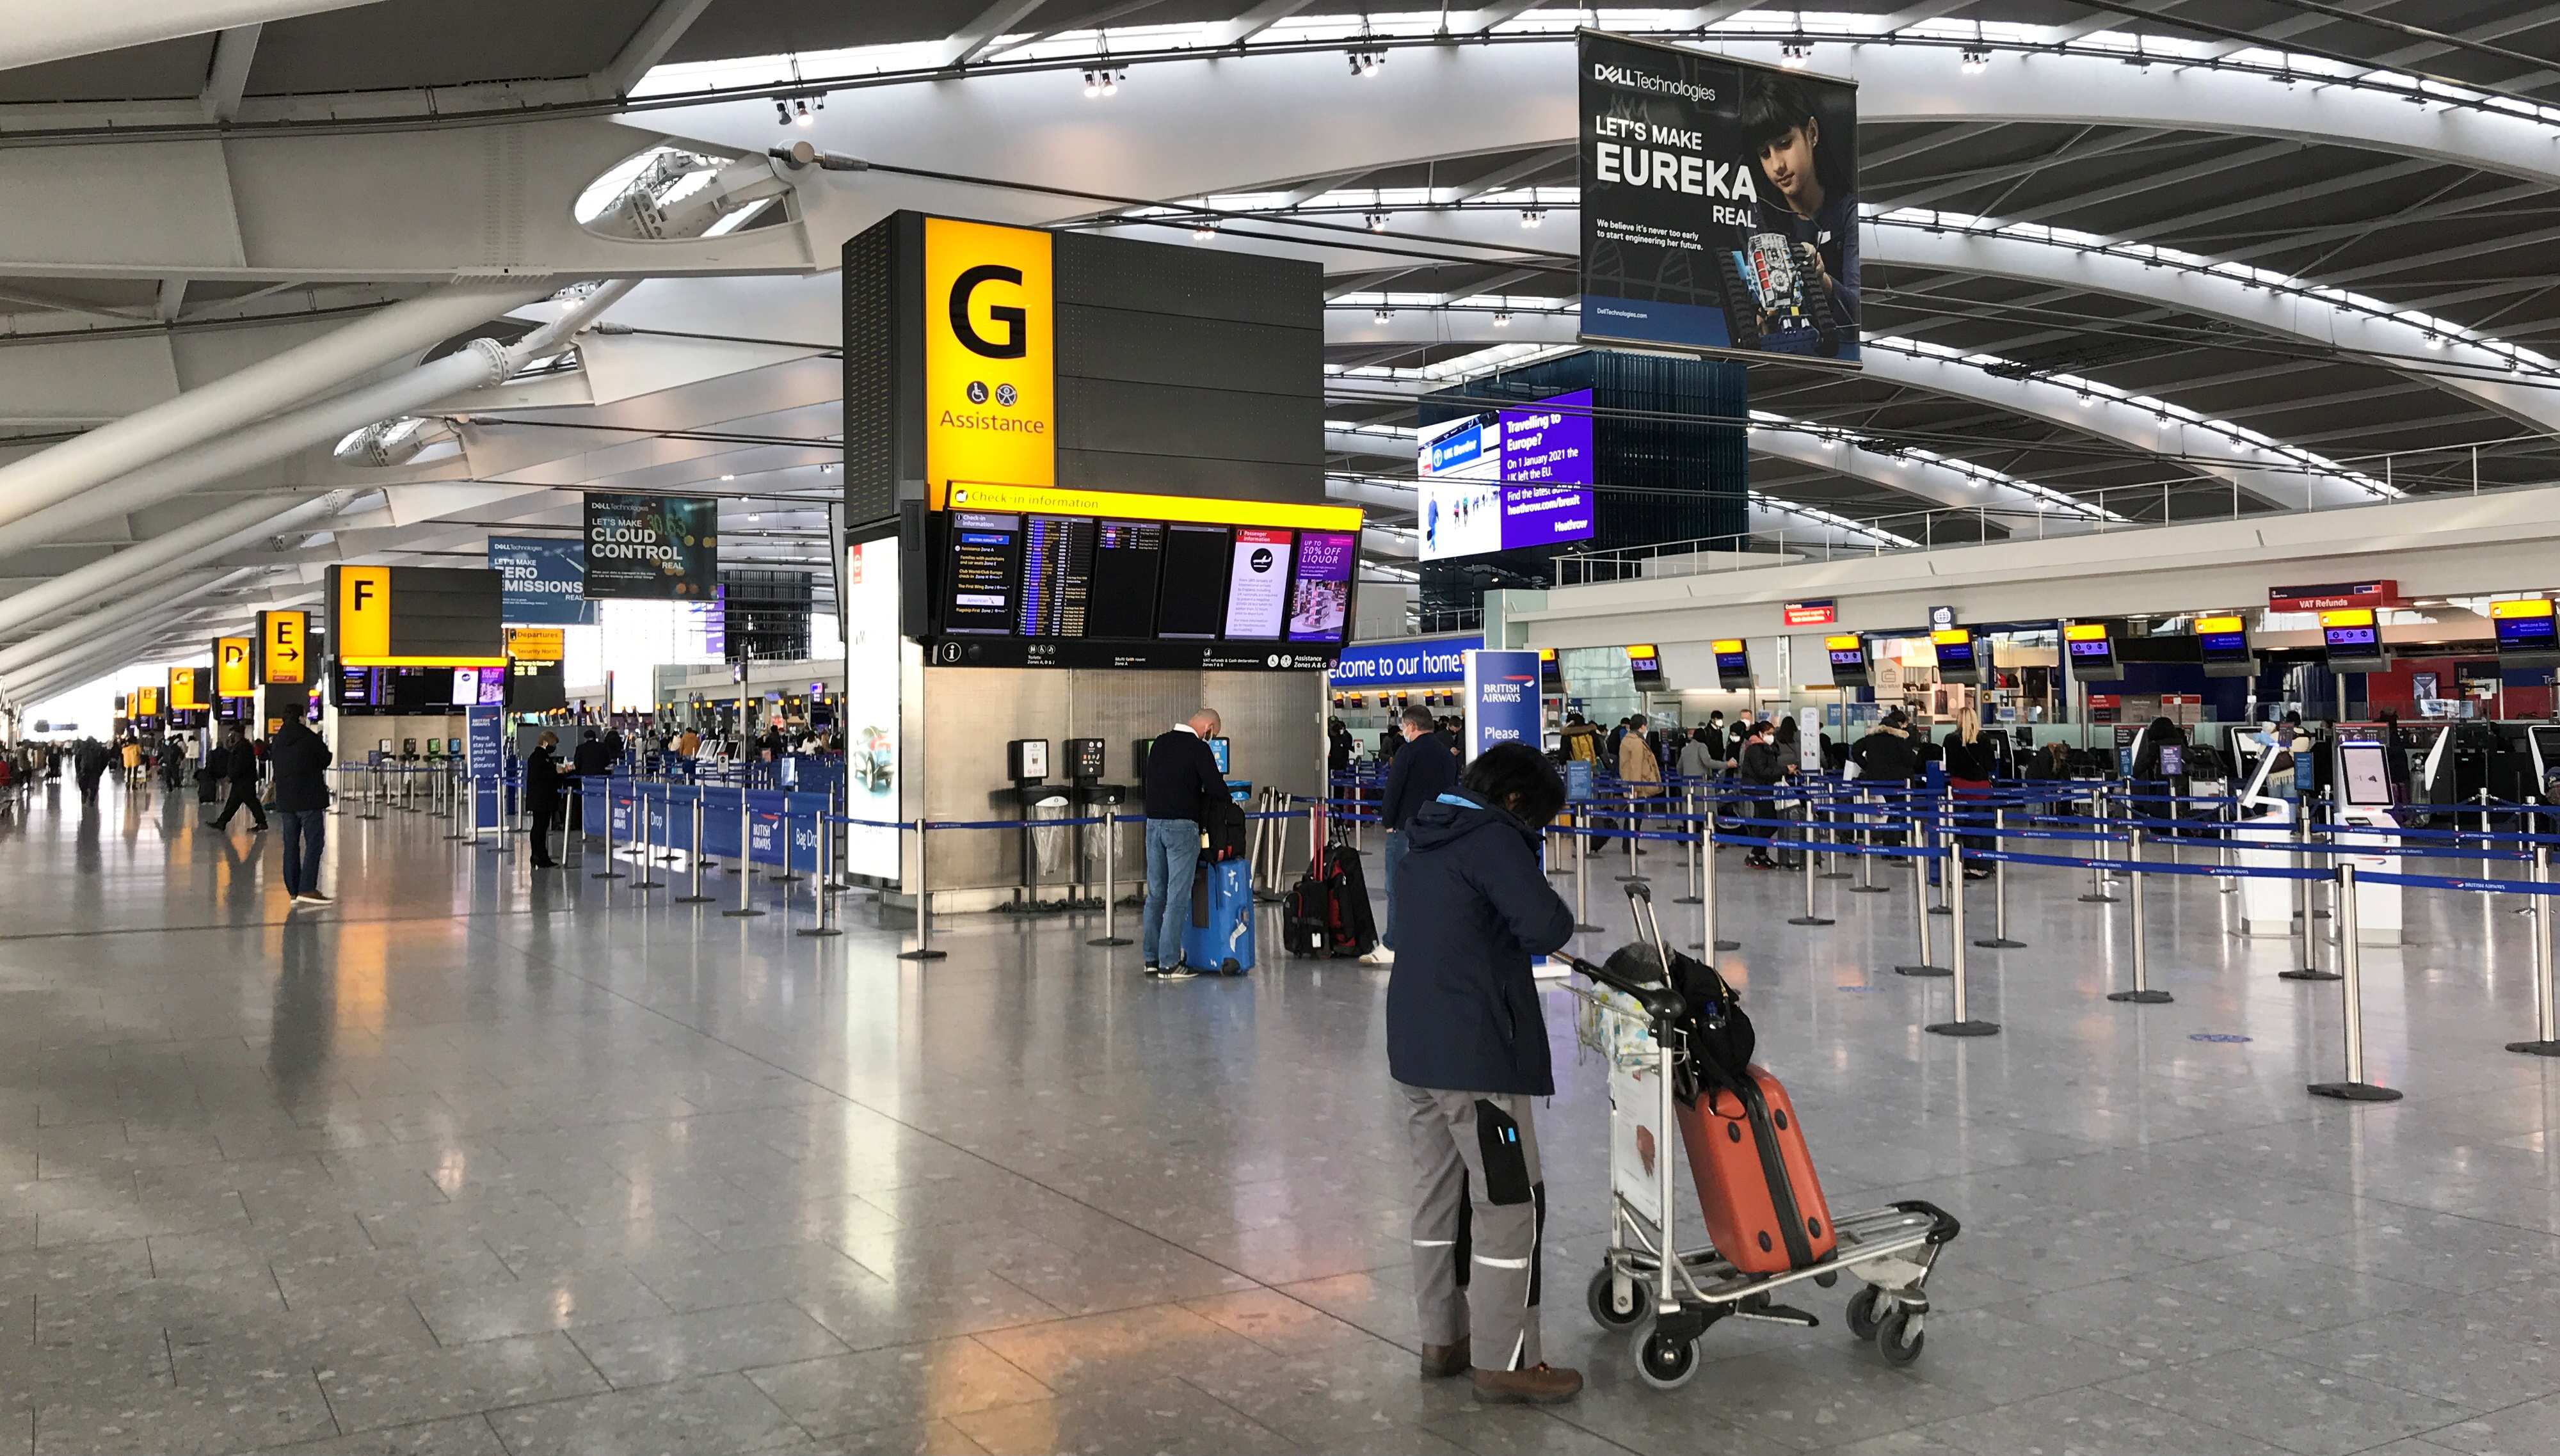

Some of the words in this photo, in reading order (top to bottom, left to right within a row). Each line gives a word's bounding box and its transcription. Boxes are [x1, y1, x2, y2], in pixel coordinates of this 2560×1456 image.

[1596, 115, 1646, 141] LET'S
[1652, 126, 1702, 150] MAKE
[1596, 142, 1757, 203] EUREKA
[1713, 205, 1757, 228] REAL
[1596, 218, 1608, 228] We
[1610, 221, 1635, 231] believe
[1636, 224, 1647, 233] it's
[1649, 227, 1668, 236] never
[1669, 229, 1681, 237] too
[1682, 232, 1699, 241] early
[1606, 232, 1624, 240] start
[1625, 234, 1666, 247] engineering
[1667, 239, 1679, 247] her
[1680, 240, 1704, 251] future.
[948, 264, 1027, 360] G
[940, 410, 1044, 435] Assistance
[1507, 415, 1549, 434] Travelling
[1550, 413, 1562, 424] to
[1507, 433, 1542, 451] Europe?
[1507, 460, 1517, 470] On
[1519, 458, 1522, 467] 1
[1523, 454, 1548, 467] January
[1549, 449, 1565, 462] 2021
[1567, 447, 1579, 458] the
[1518, 470, 1529, 481] left
[1530, 468, 1540, 479] the
[1542, 466, 1553, 477] EU.
[972, 491, 1025, 504] Check-in
[1028, 493, 1099, 509] information
[1507, 491, 1521, 502] Find
[1522, 489, 1533, 499] the
[1507, 494, 1581, 516] heathrow.com/brexit
[592, 518, 616, 526] LET'S
[618, 519, 643, 527] MAKE
[1555, 519, 1588, 532] Heathrow
[591, 527, 657, 543] CLOUD
[591, 543, 683, 560] CONTROL
[1302, 555, 1338, 564] LIQUOR
[1303, 546, 1322, 555] 50%
[1324, 547, 1342, 556] OFF
[354, 580, 374, 611] F
[502, 580, 584, 593] MISSIONS
[2299, 600, 2314, 609] VAT
[2315, 598, 2348, 608] Refunds
[277, 621, 292, 644] E
[225, 646, 243, 666] D
[1329, 660, 1375, 678] ecome
[1379, 657, 1393, 676] to
[1396, 657, 1420, 676] our
[1423, 650, 1462, 674] home.
[143, 689, 152, 700] B
[1484, 684, 1520, 693] BRITISH
[1482, 693, 1521, 703] AIRWAYS
[1485, 726, 1519, 739] Please
[650, 811, 662, 830] Drop
[753, 823, 771, 836] BRITISH
[752, 836, 771, 851] AIRWAYS
[796, 828, 806, 851] Bag
[807, 829, 817, 848] Dro
